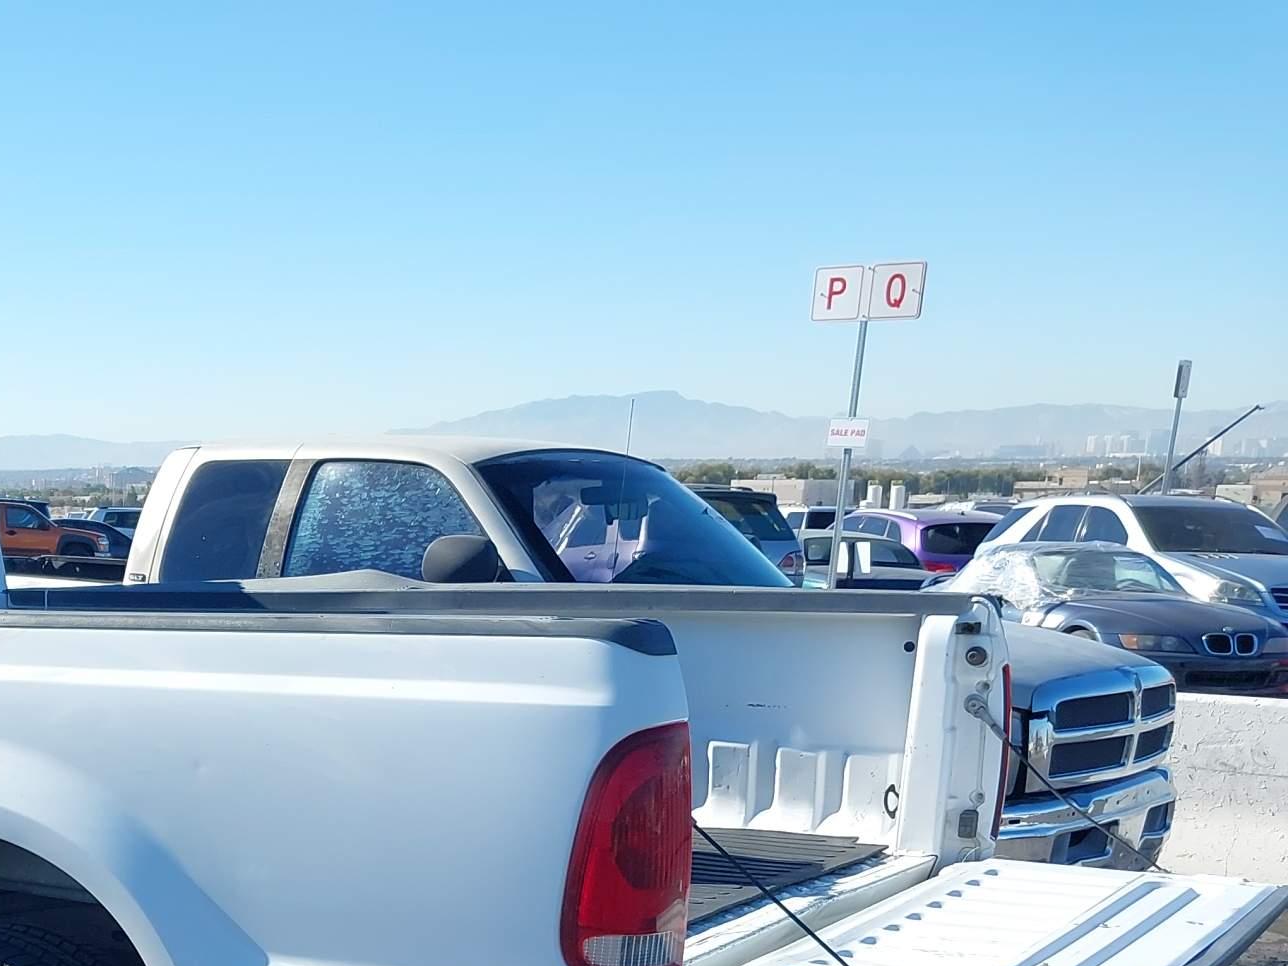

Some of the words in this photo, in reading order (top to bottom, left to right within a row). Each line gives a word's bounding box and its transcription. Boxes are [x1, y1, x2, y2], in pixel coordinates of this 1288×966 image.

[826, 277, 847, 310] P
[885, 273, 906, 309] Q
[830, 428, 849, 437] SALE
[849, 428, 866, 437] PAD
